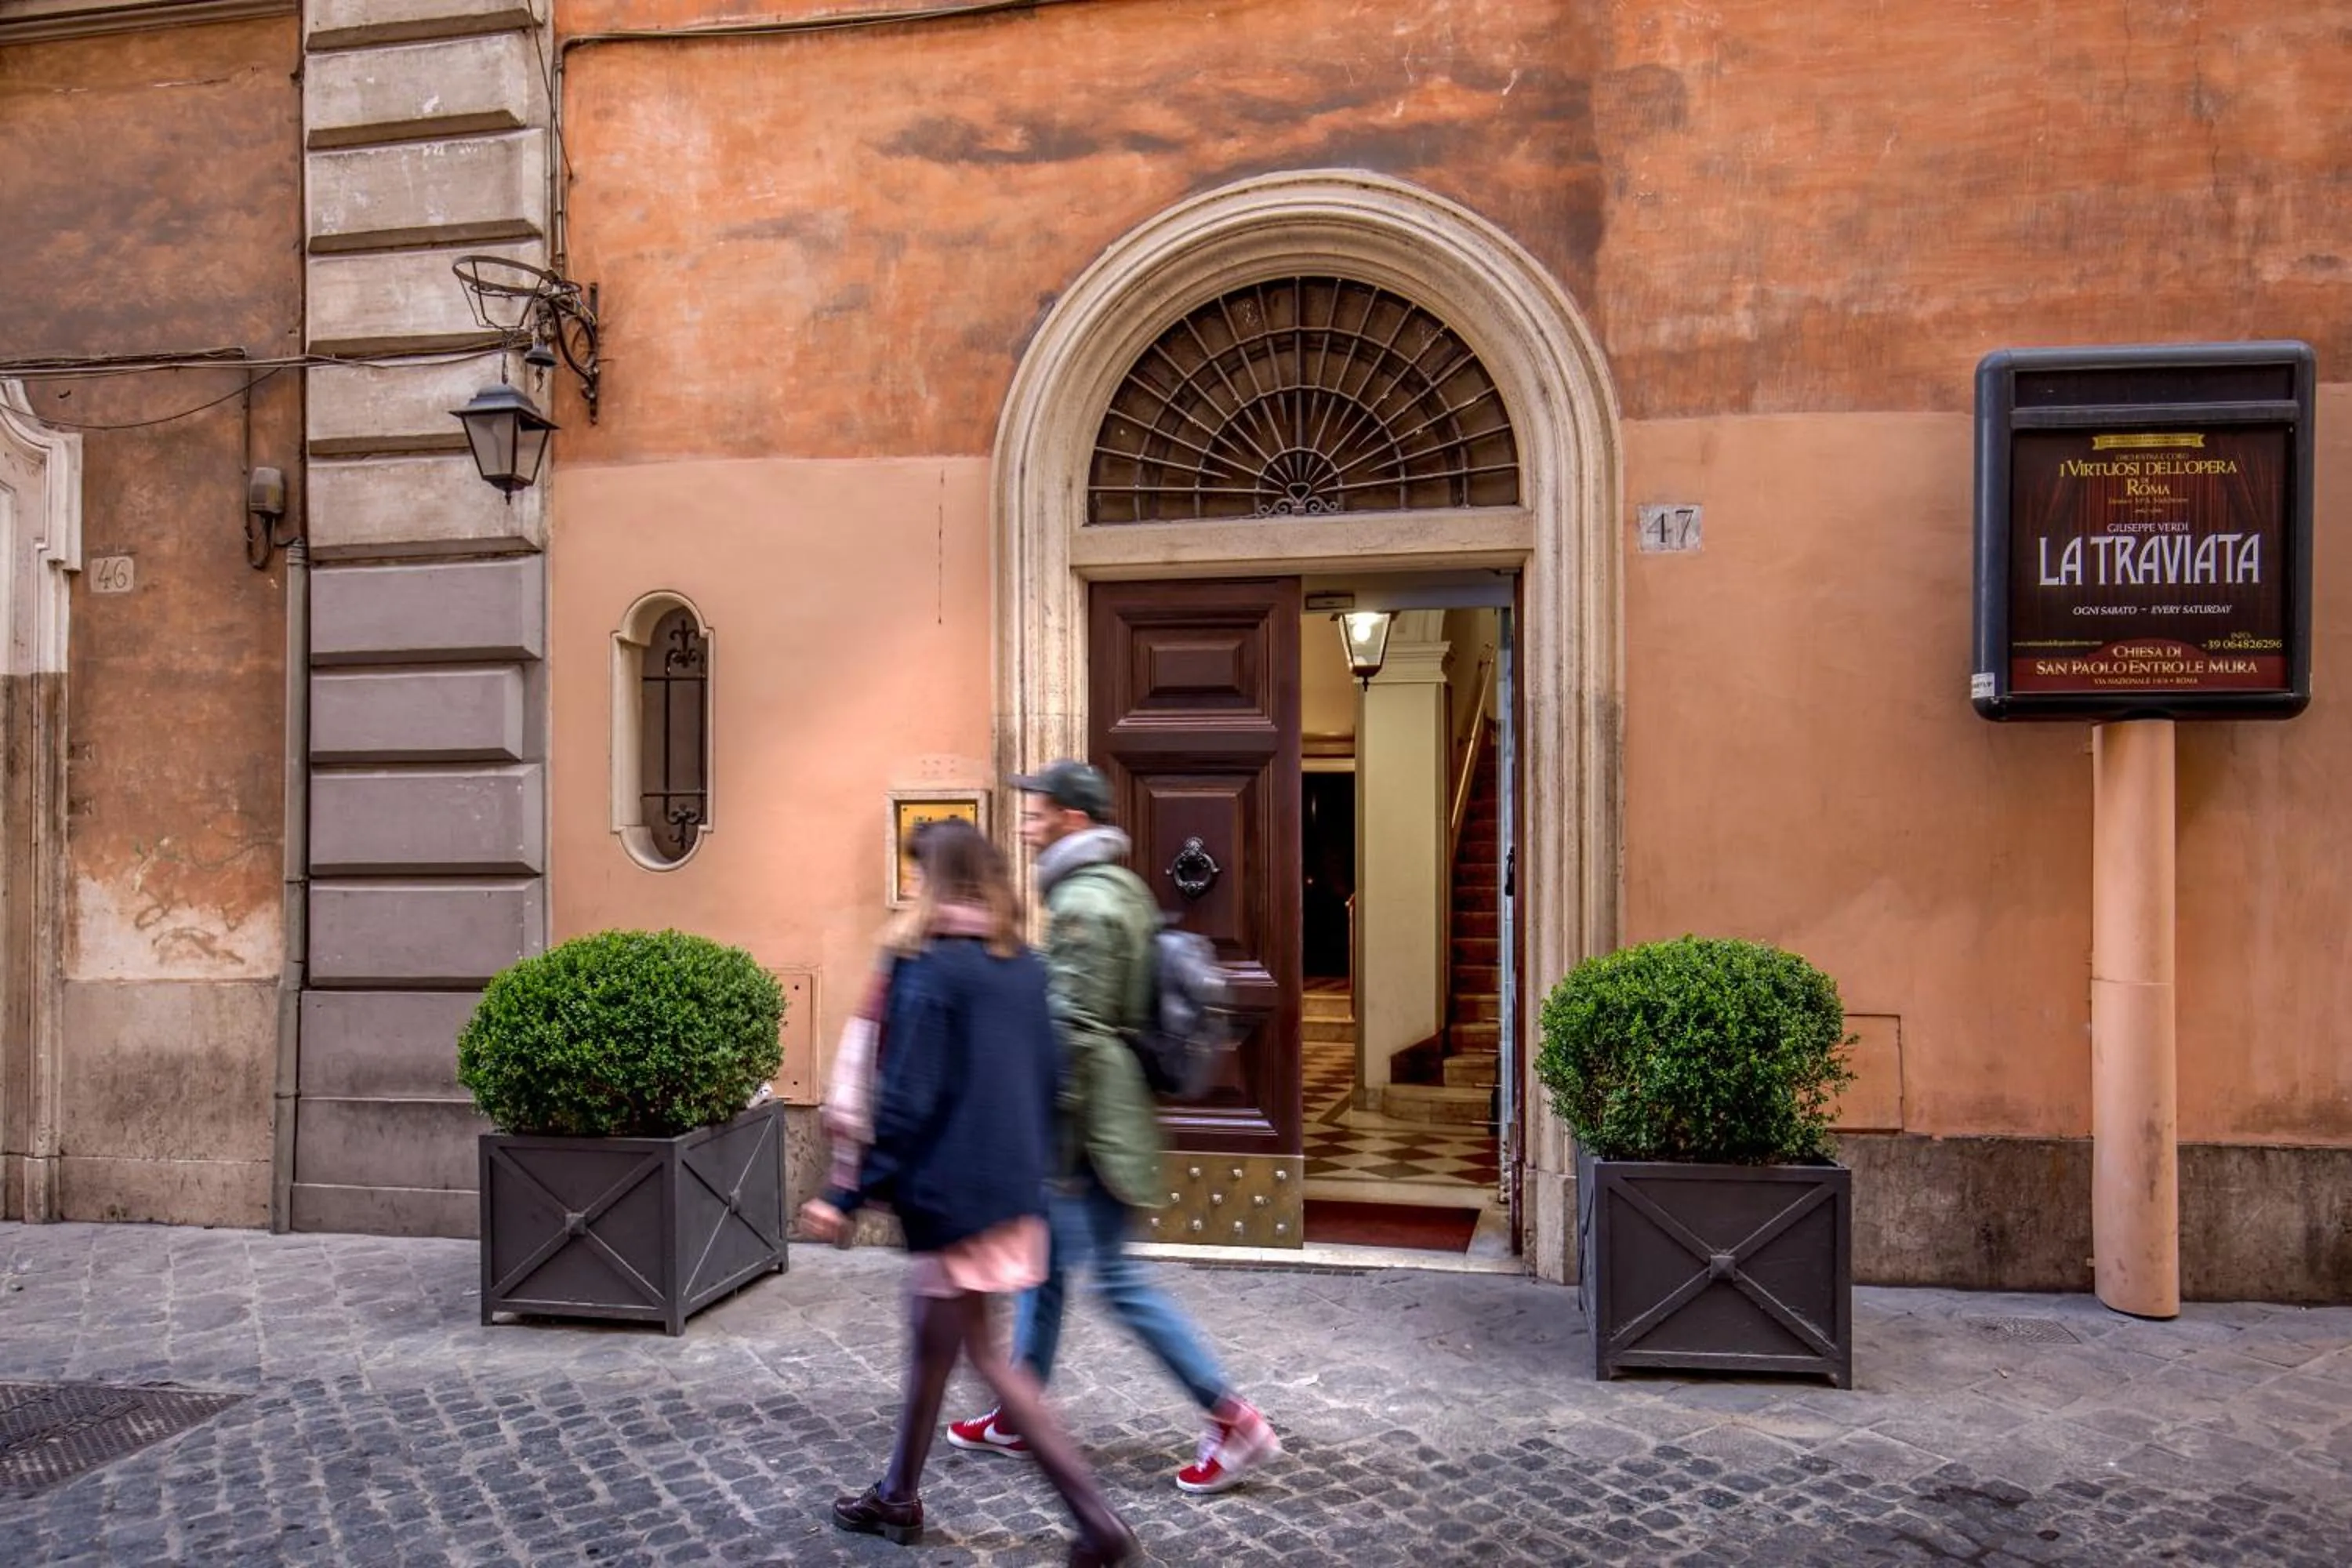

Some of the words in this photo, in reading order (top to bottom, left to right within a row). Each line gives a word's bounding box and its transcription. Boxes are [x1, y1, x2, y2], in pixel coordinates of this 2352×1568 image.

[2059, 463, 2064, 477] I
[2066, 459, 2140, 477] VIRTUOSI
[2146, 460, 2238, 475] DELL'OPERA
[2126, 478, 2170, 495] ROMA
[1646, 509, 1693, 543] 47
[2107, 523, 2155, 533] GIUSEPPE
[2158, 521, 2189, 532] VERDI
[2038, 536, 2083, 586] LA
[2089, 533, 2261, 586] TRAVIATA
[98, 560, 127, 590] 46
[2072, 606, 2100, 615] OGNI
[2100, 606, 2138, 615] SABATO
[2151, 605, 2181, 615] EVERY
[2182, 604, 2234, 615] SATURDAY
[2112, 645, 2163, 658] CHIESA
[2166, 645, 2183, 658] DI
[2036, 661, 2068, 675] SAN
[2071, 660, 2127, 675] PAOLO
[2129, 660, 2184, 674] ENTRO
[2186, 660, 2204, 673] LE
[2208, 659, 2259, 673] MURA
